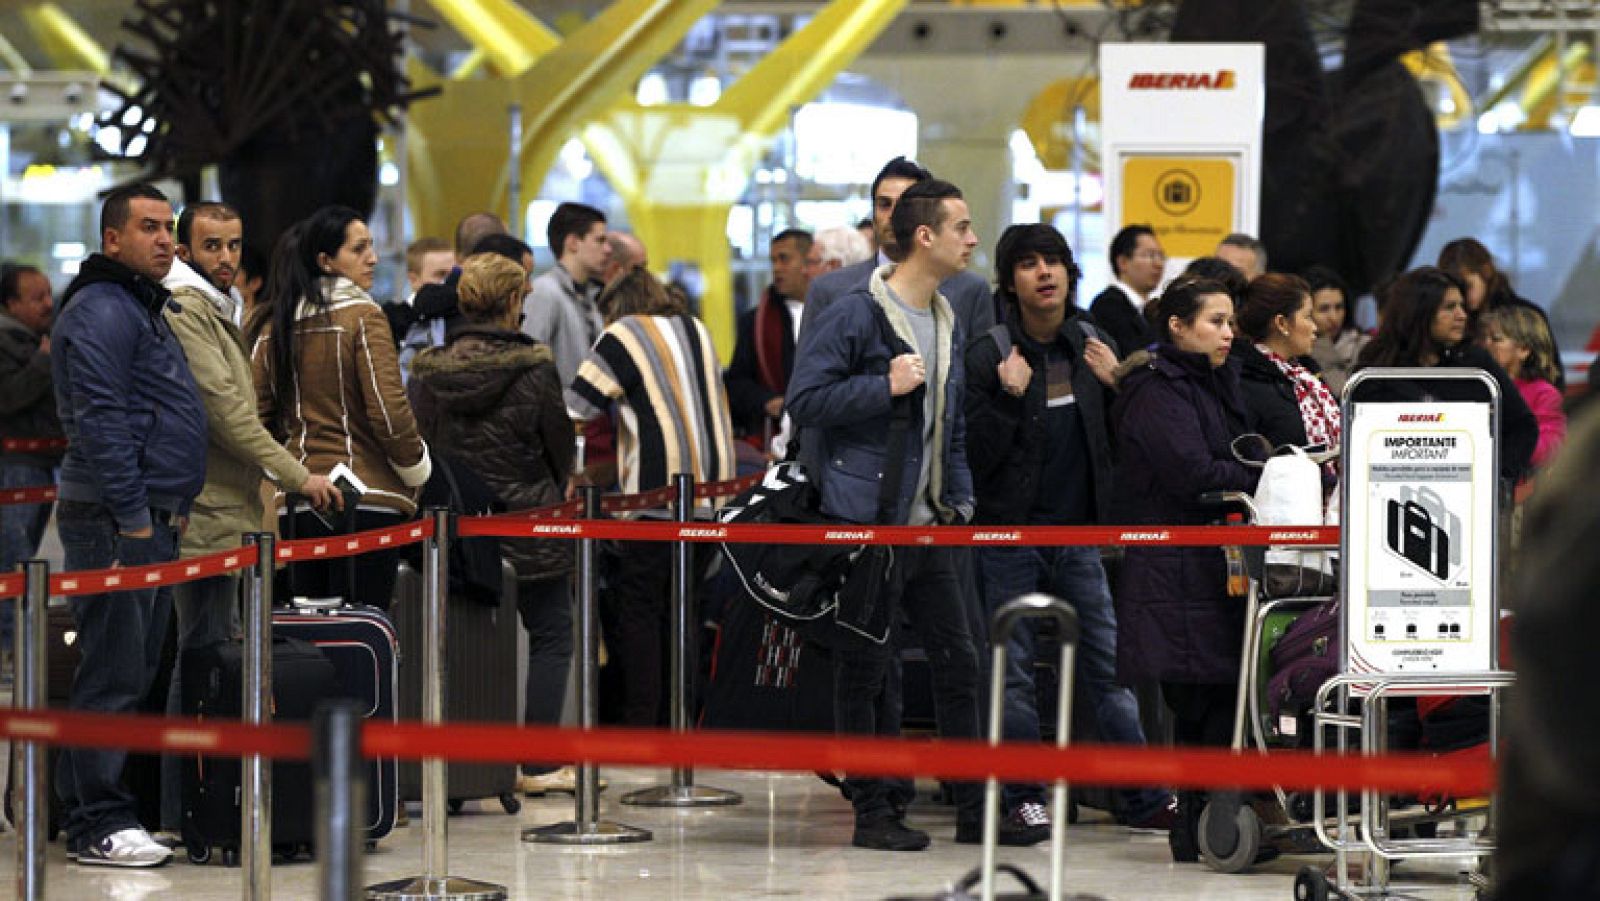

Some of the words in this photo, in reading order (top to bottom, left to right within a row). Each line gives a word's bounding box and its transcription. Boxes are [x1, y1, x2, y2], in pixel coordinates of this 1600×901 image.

[1128, 73, 1214, 89] IBERIA
[1397, 414, 1434, 422] IBERIA
[1384, 437, 1457, 447] IMPORTANTE
[1391, 448, 1449, 459] IMPORTANT
